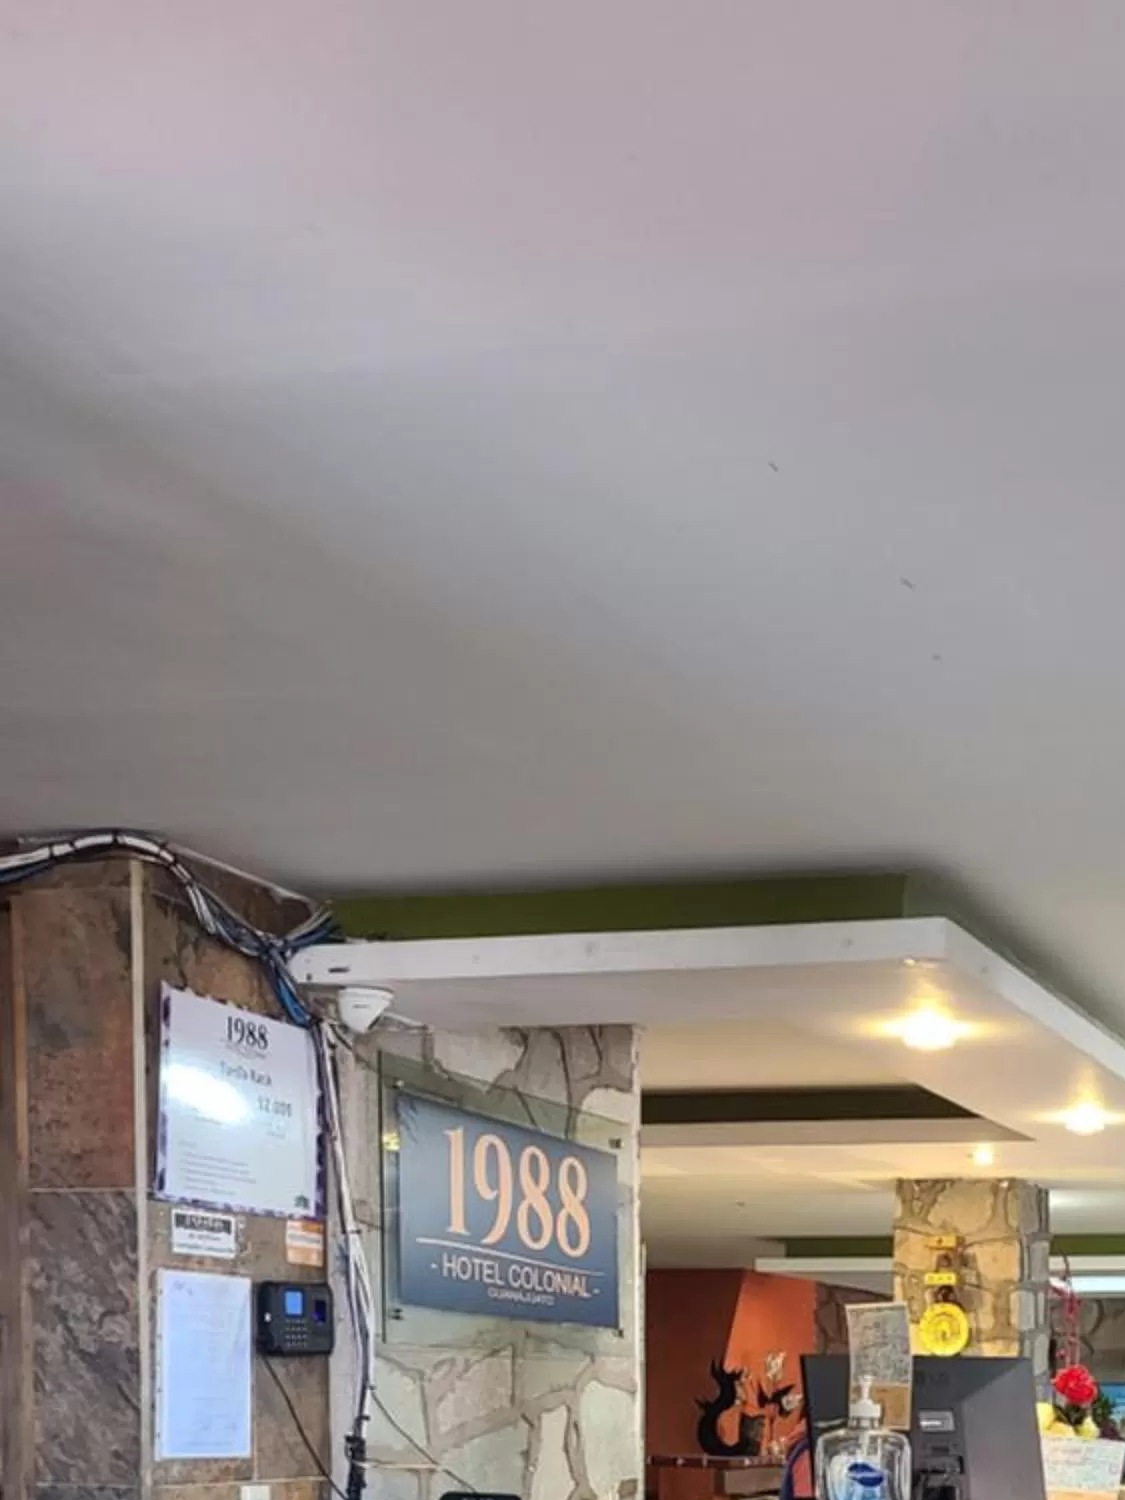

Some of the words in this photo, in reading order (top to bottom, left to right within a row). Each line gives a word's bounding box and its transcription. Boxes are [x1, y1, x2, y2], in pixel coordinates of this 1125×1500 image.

[227, 1016, 269, 1050] 1988
[443, 1126, 591, 1258] 1988
[442, 1253, 505, 1286] HOTEL
[508, 1264, 591, 1298] COLONIAL
